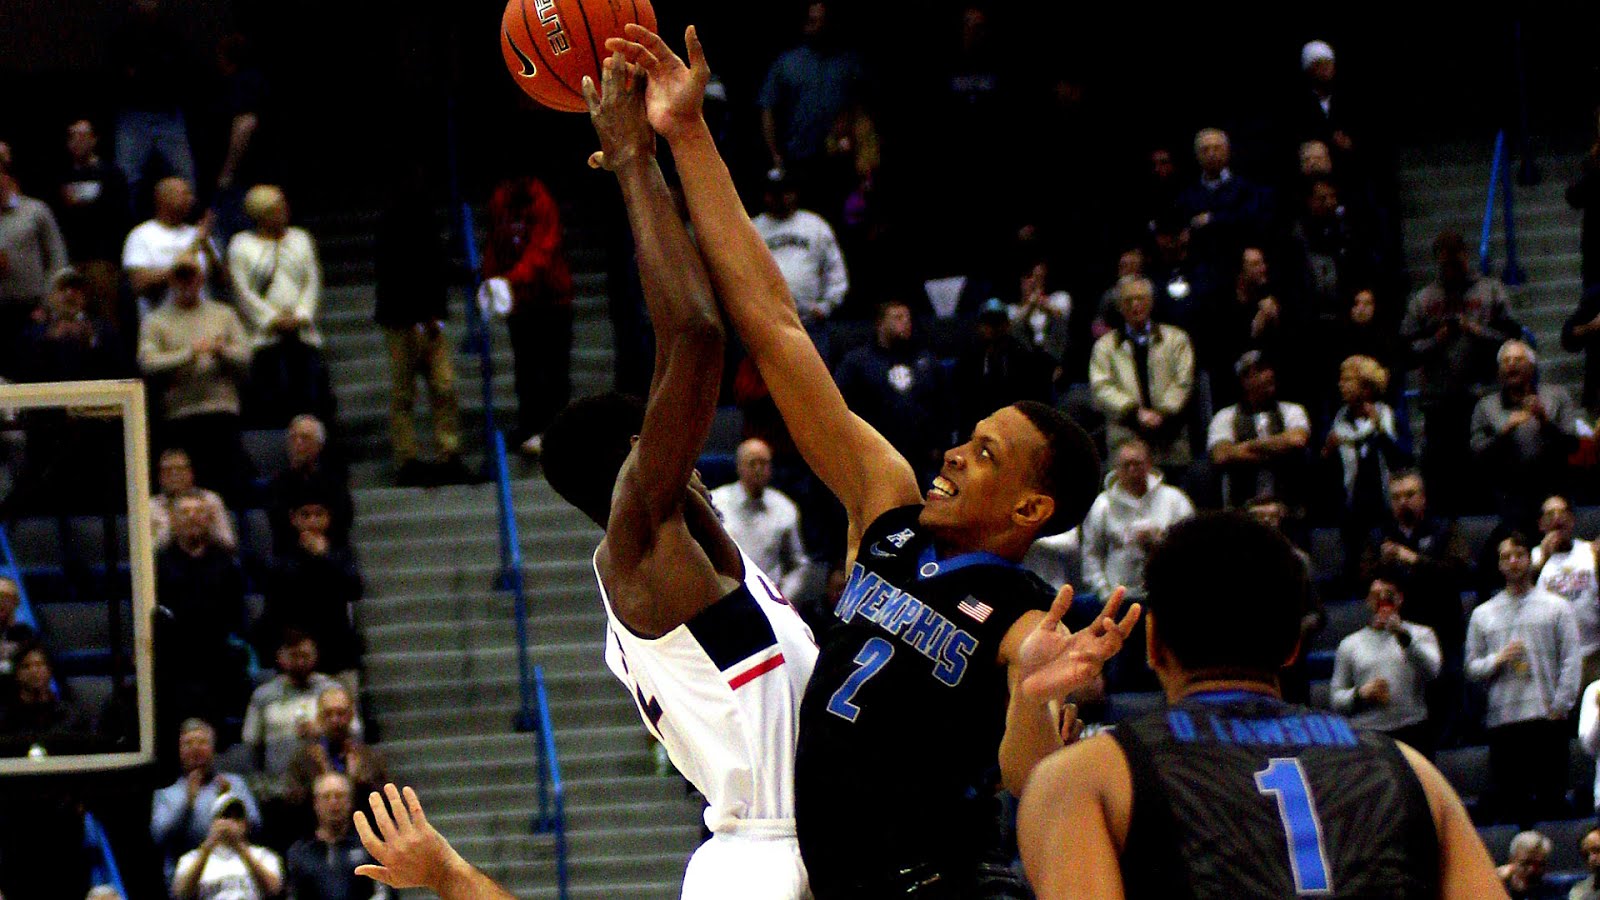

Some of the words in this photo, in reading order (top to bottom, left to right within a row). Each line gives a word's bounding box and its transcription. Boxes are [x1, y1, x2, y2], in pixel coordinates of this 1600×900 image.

[827, 637, 895, 723] 2
[834, 562, 979, 686] MEMPHIS
[1253, 757, 1334, 896] 1
